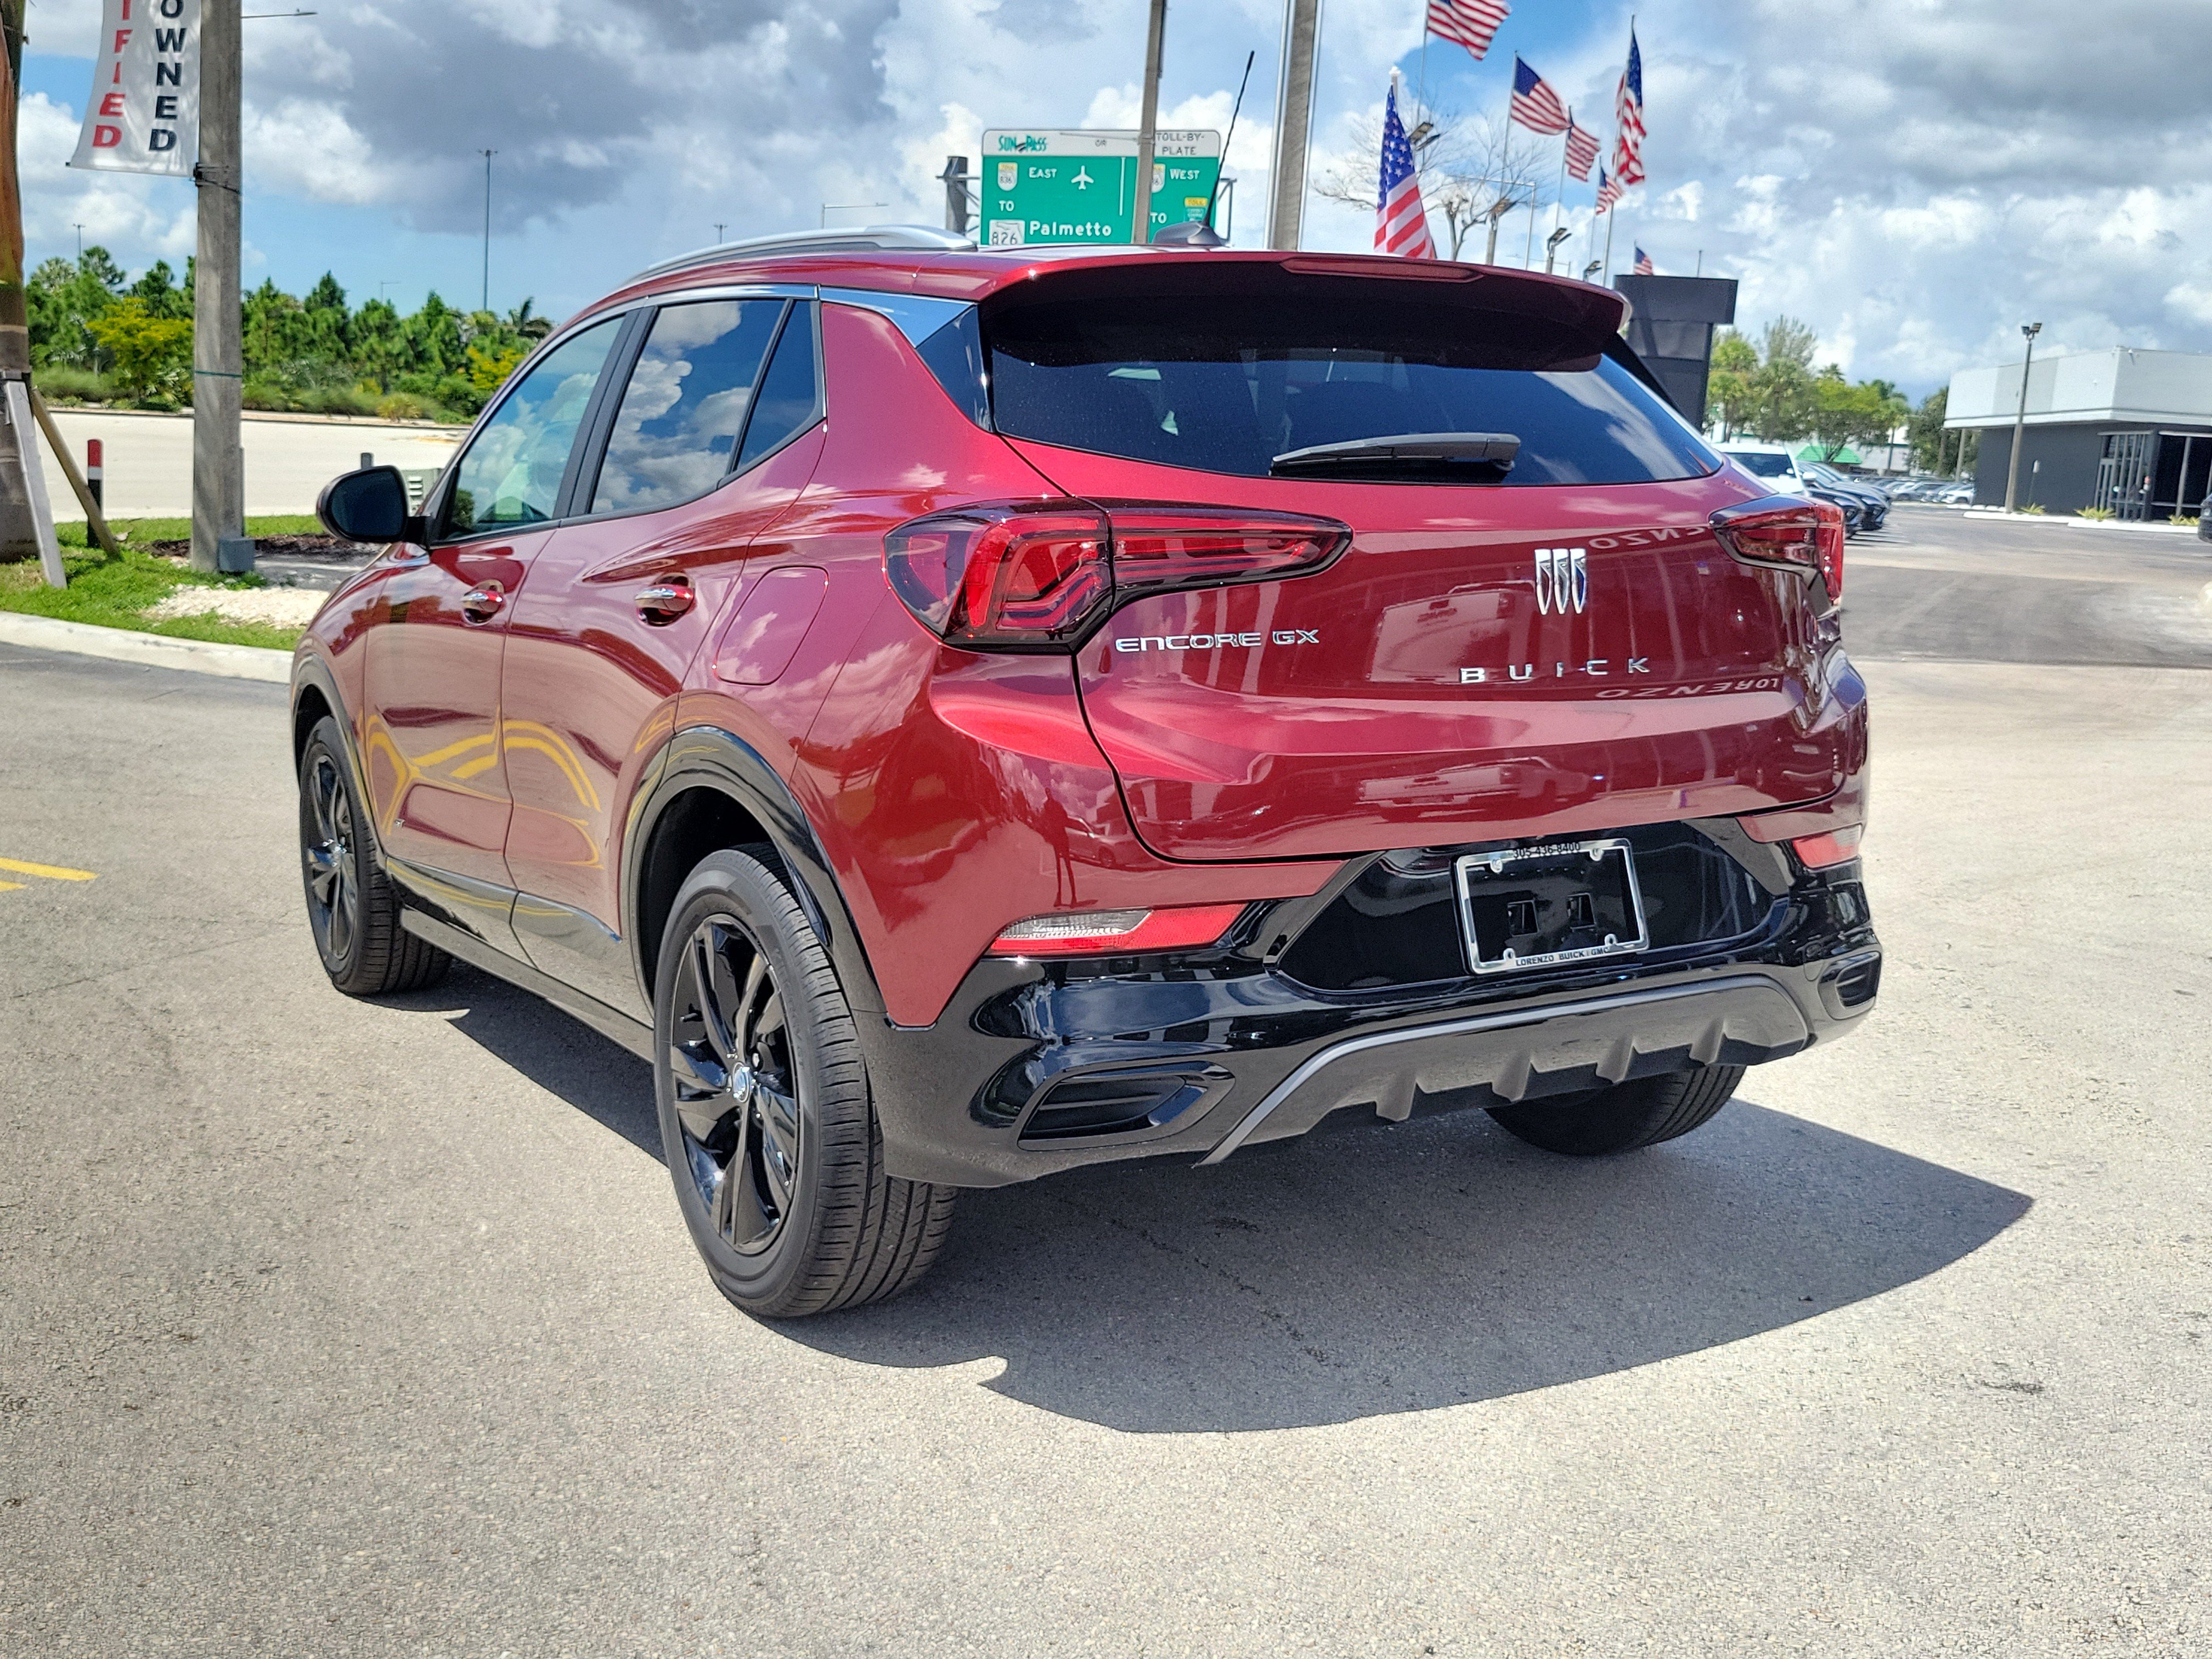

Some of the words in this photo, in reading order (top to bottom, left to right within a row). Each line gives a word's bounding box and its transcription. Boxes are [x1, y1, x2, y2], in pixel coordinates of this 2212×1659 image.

[149, 0, 187, 151] OWNED
[1095, 139, 1107, 147] OR
[1162, 146, 1197, 156] PLATE
[1029, 167, 1057, 179] EAST
[1170, 168, 1200, 180] WEST
[998, 200, 1014, 212] TO
[1150, 212, 1167, 224] TO
[1029, 221, 1112, 236] Palmetto
[991, 232, 1018, 246] 826
[1115, 632, 1261, 652] ENCORE
[1272, 629, 1319, 645] GX
[1460, 657, 1651, 684] BUICK
[1513, 842, 1581, 859] 305-436-8400
[1515, 954, 1555, 967] LORENZO
[1559, 951, 1585, 961] BUICK
[1591, 947, 1609, 956] GMC
